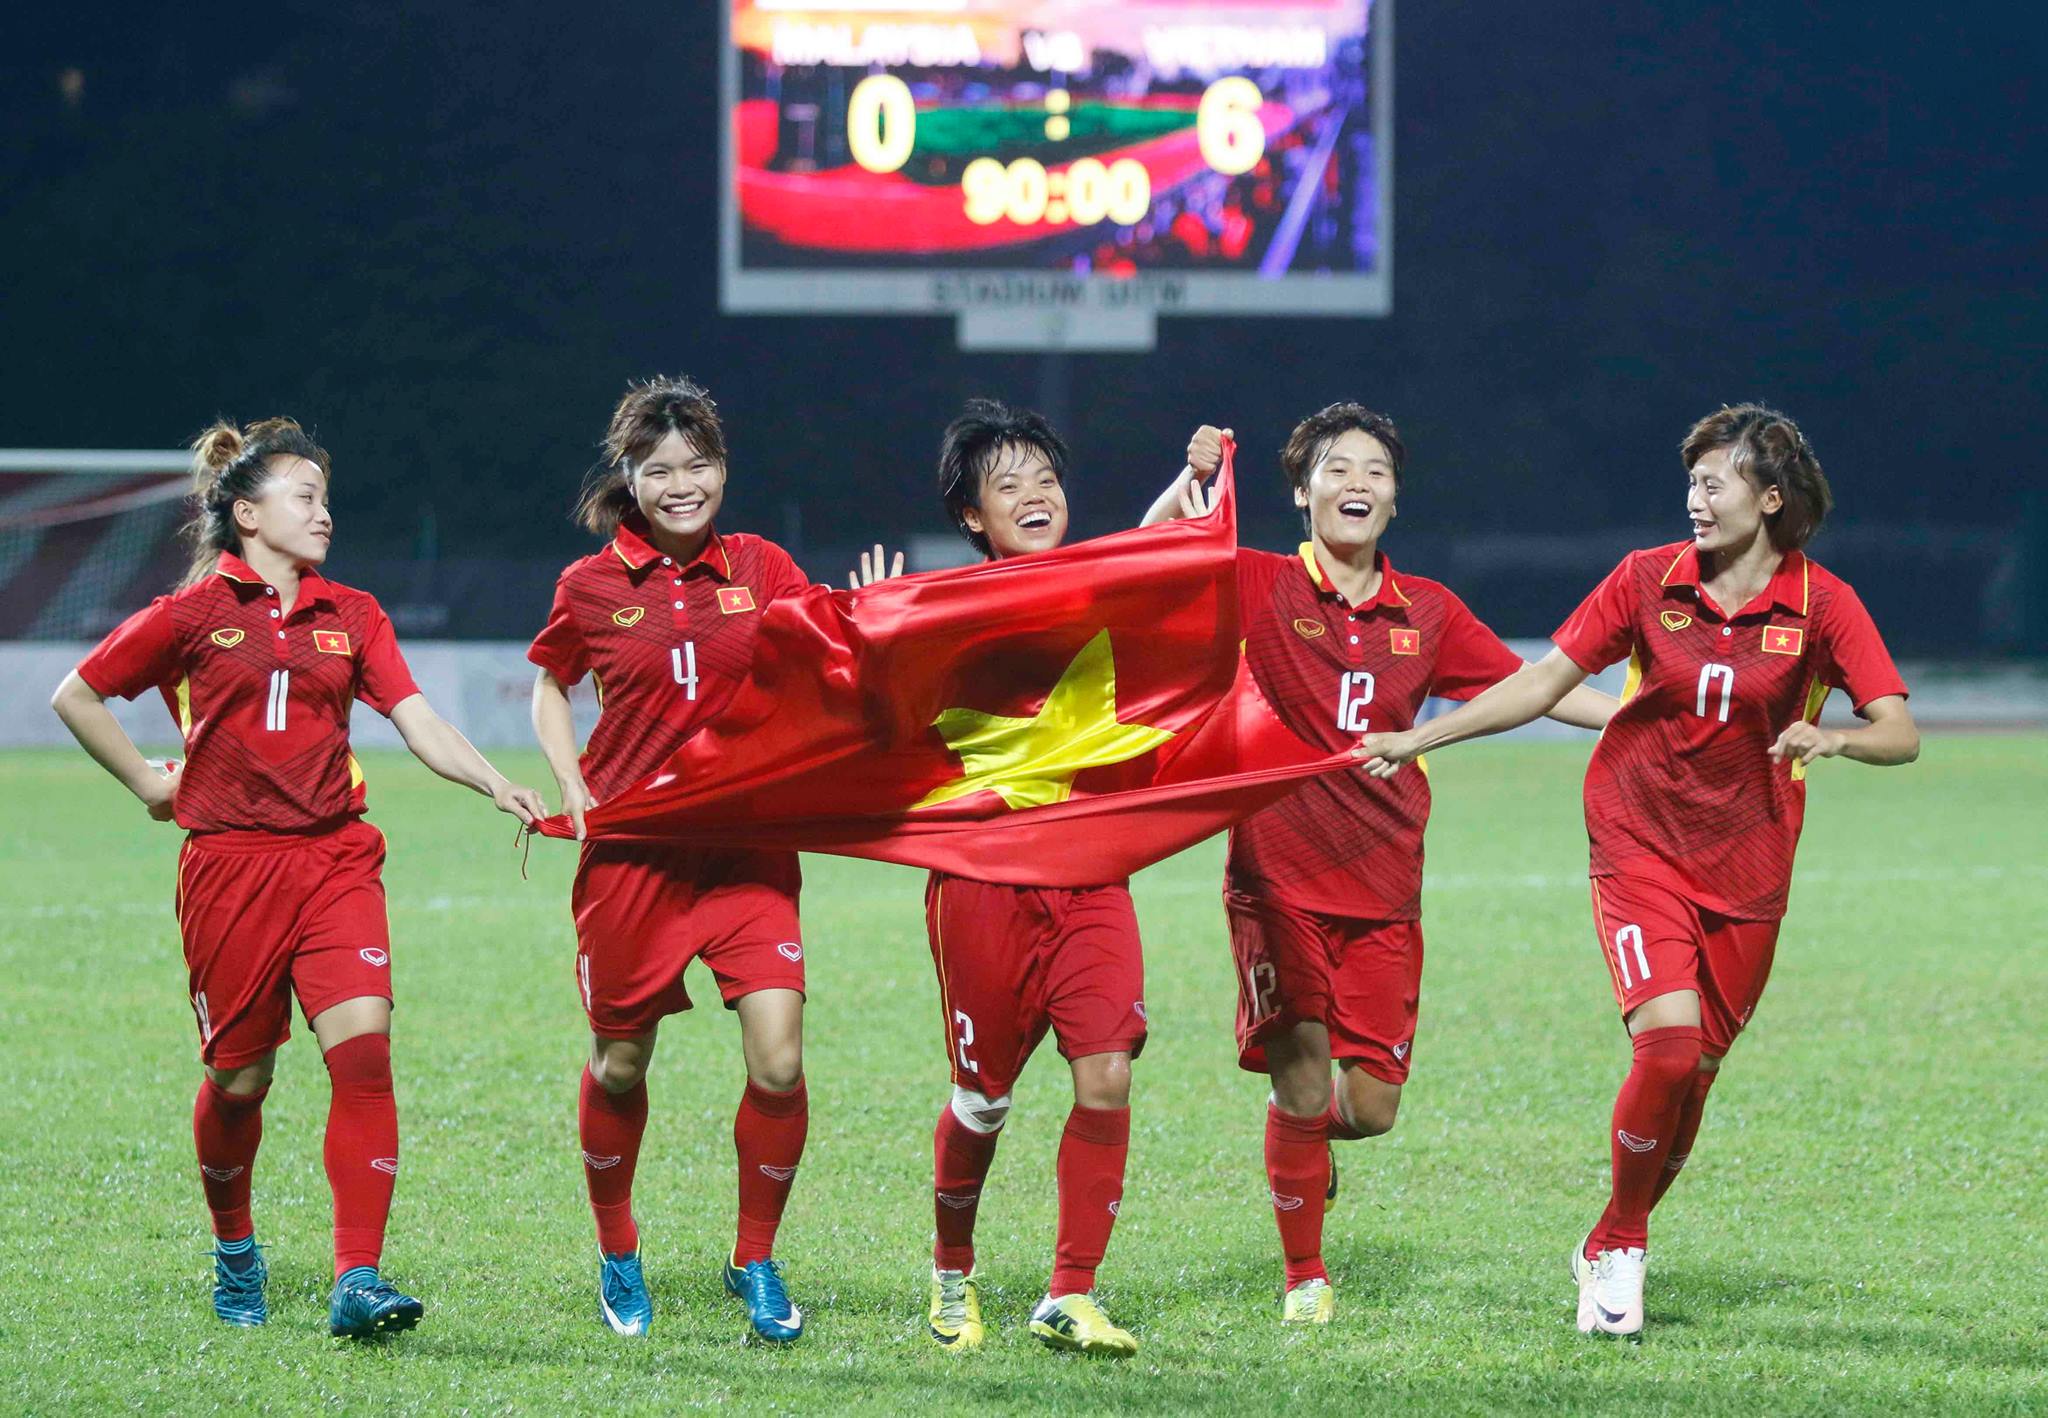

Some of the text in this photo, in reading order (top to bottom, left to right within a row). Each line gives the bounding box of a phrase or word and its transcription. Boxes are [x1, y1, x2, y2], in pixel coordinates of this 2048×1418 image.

[848, 75, 916, 172] 0
[1197, 76, 1265, 175] 6
[962, 158, 1151, 225] 90:00
[265, 669, 289, 732] 11
[671, 641, 699, 701] 4
[1336, 671, 1375, 732] 12
[1696, 662, 1735, 723] 17
[1615, 923, 1653, 990] 17
[1249, 962, 1282, 1022] 12
[955, 1008, 979, 1074] 2
